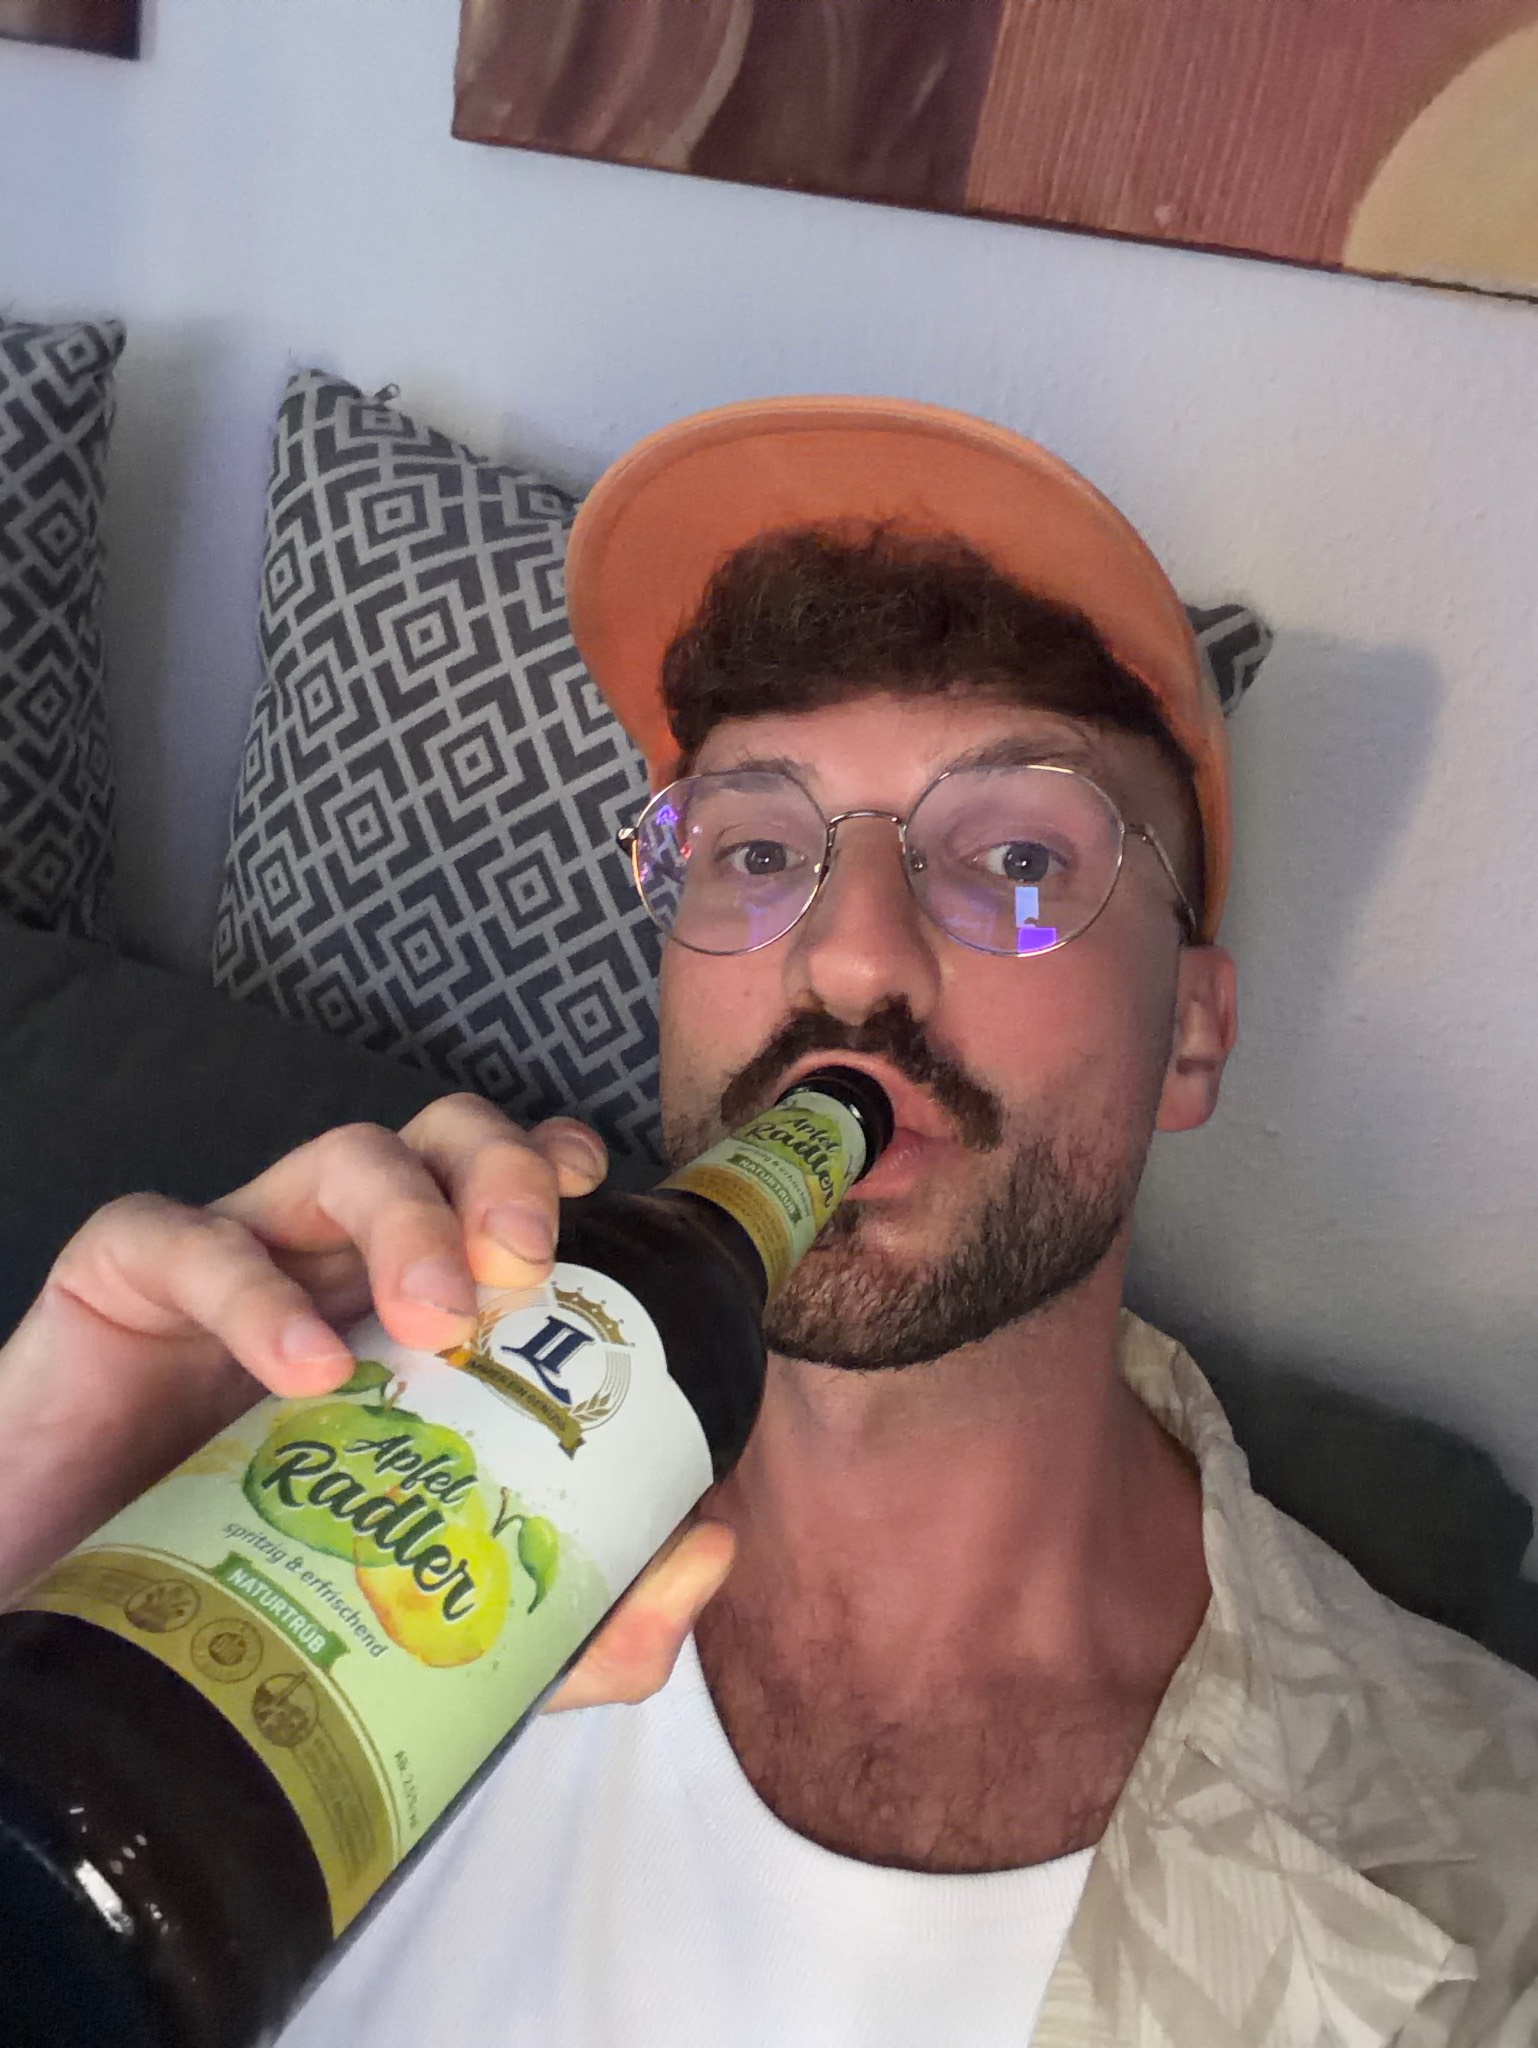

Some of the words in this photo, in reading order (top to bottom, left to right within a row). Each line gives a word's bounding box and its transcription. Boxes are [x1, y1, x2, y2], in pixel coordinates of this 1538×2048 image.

[747, 1122, 834, 1208] Radler
[344, 1434, 479, 1504] Apfel
[261, 1440, 476, 1622] Radler
[224, 1522, 286, 1565] spritzig
[285, 1556, 304, 1575] &
[300, 1566, 389, 1659] erfrischend
